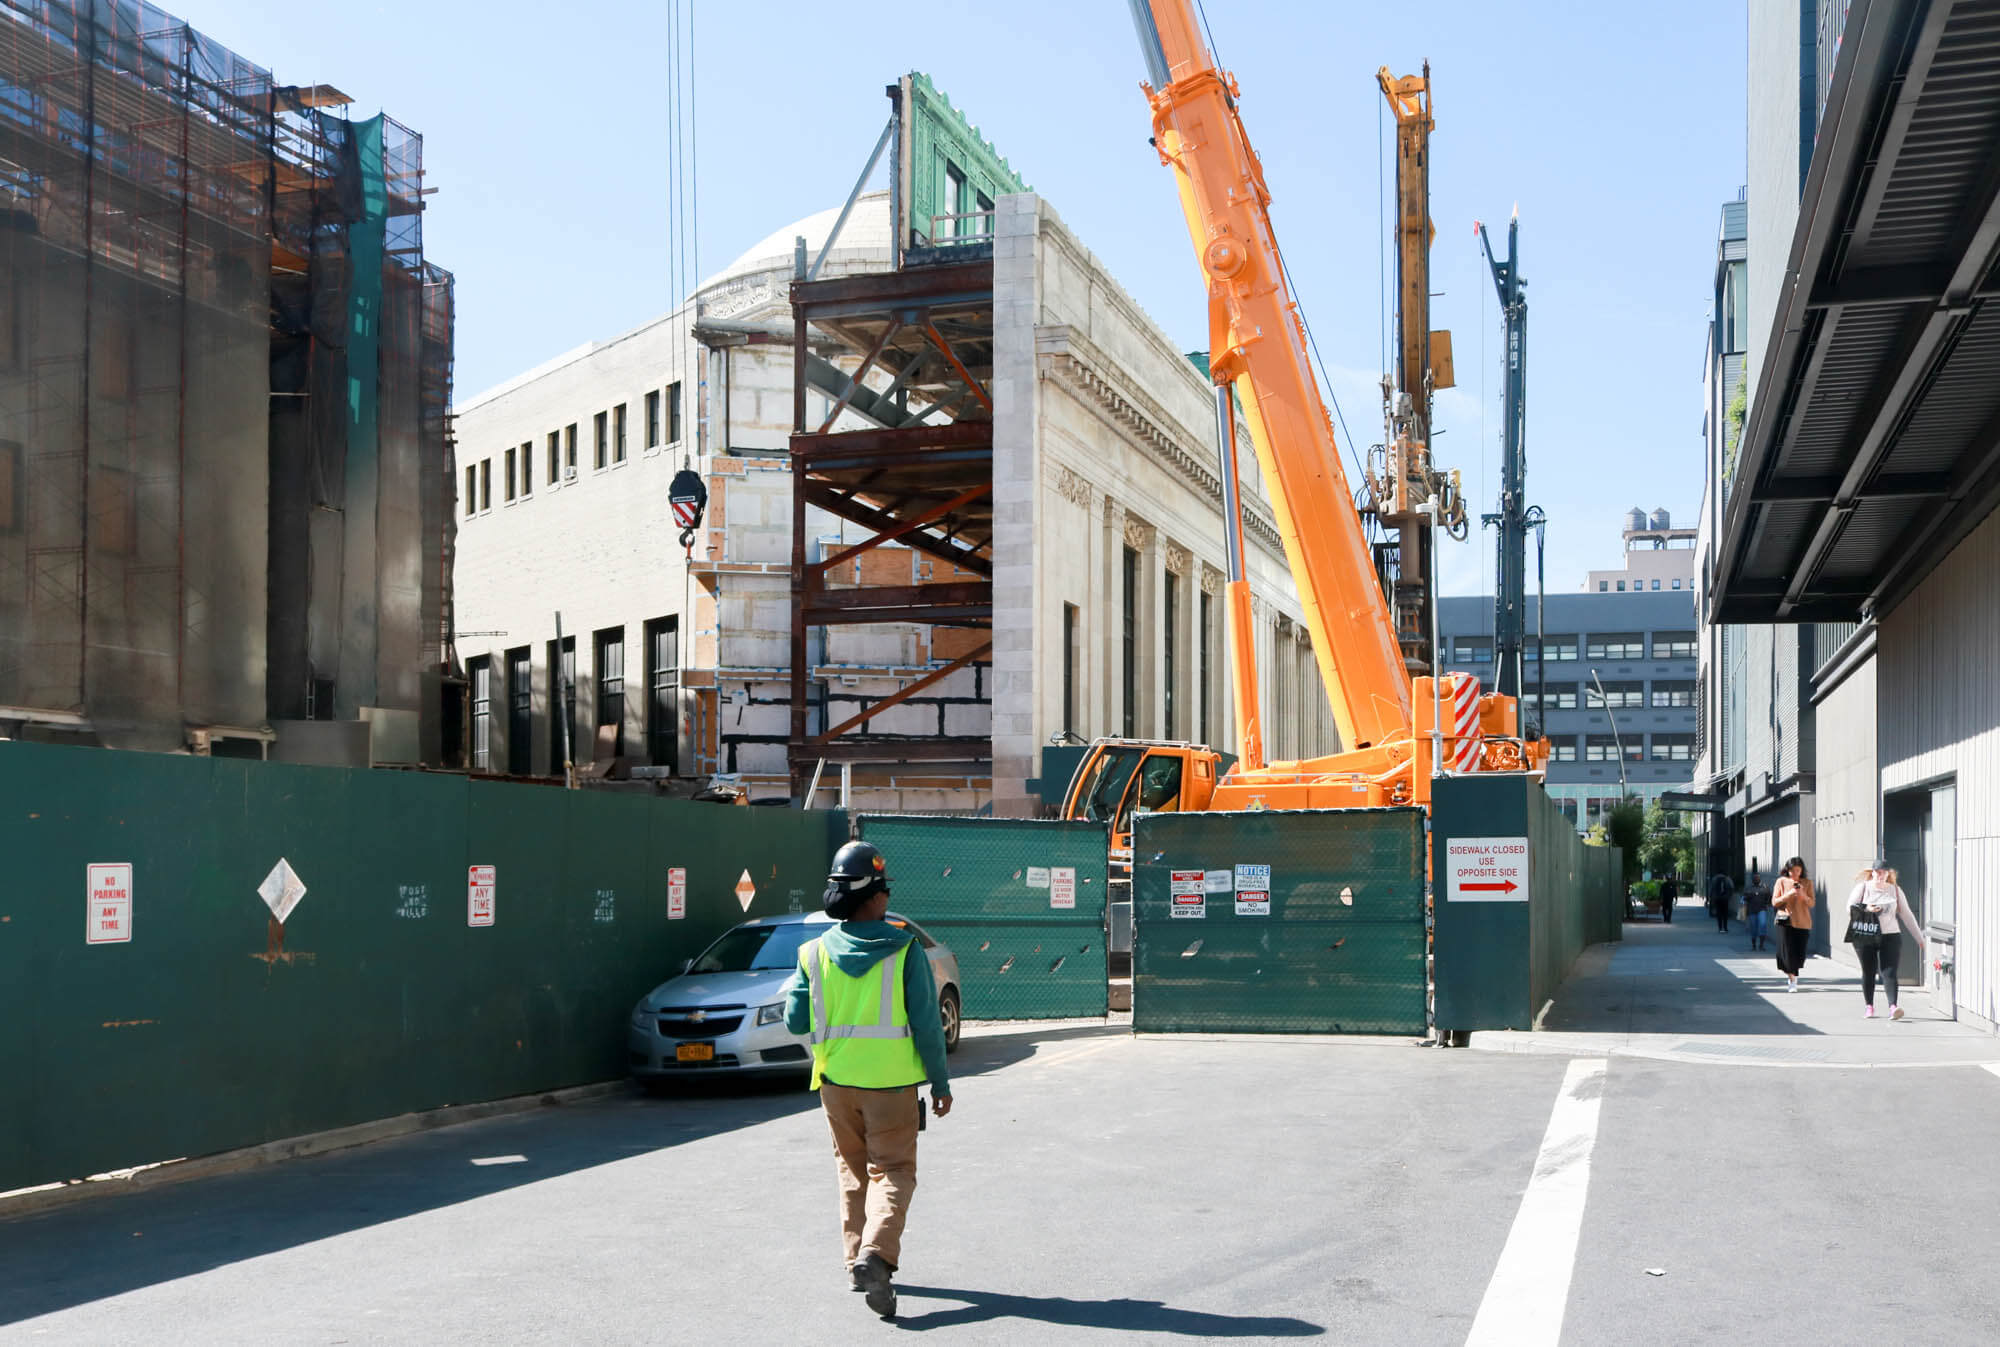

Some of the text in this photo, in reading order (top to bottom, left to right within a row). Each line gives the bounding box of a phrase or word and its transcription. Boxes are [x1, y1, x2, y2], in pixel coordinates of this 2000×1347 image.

[1449, 845, 1525, 854] SIDEWALK CLOSED
[1479, 857, 1495, 865] USE
[1237, 865, 1269, 876] NOTICE
[1457, 868, 1518, 877] OPPOSITE SIDE
[105, 877, 115, 886] NO
[94, 889, 127, 899] PARKING
[475, 888, 488, 897] ANY
[672, 887, 681, 896] ANY
[474, 899, 490, 910] TIME
[672, 896, 681, 905] TIME
[103, 908, 117, 917] ANY
[102, 920, 119, 929] TIME
